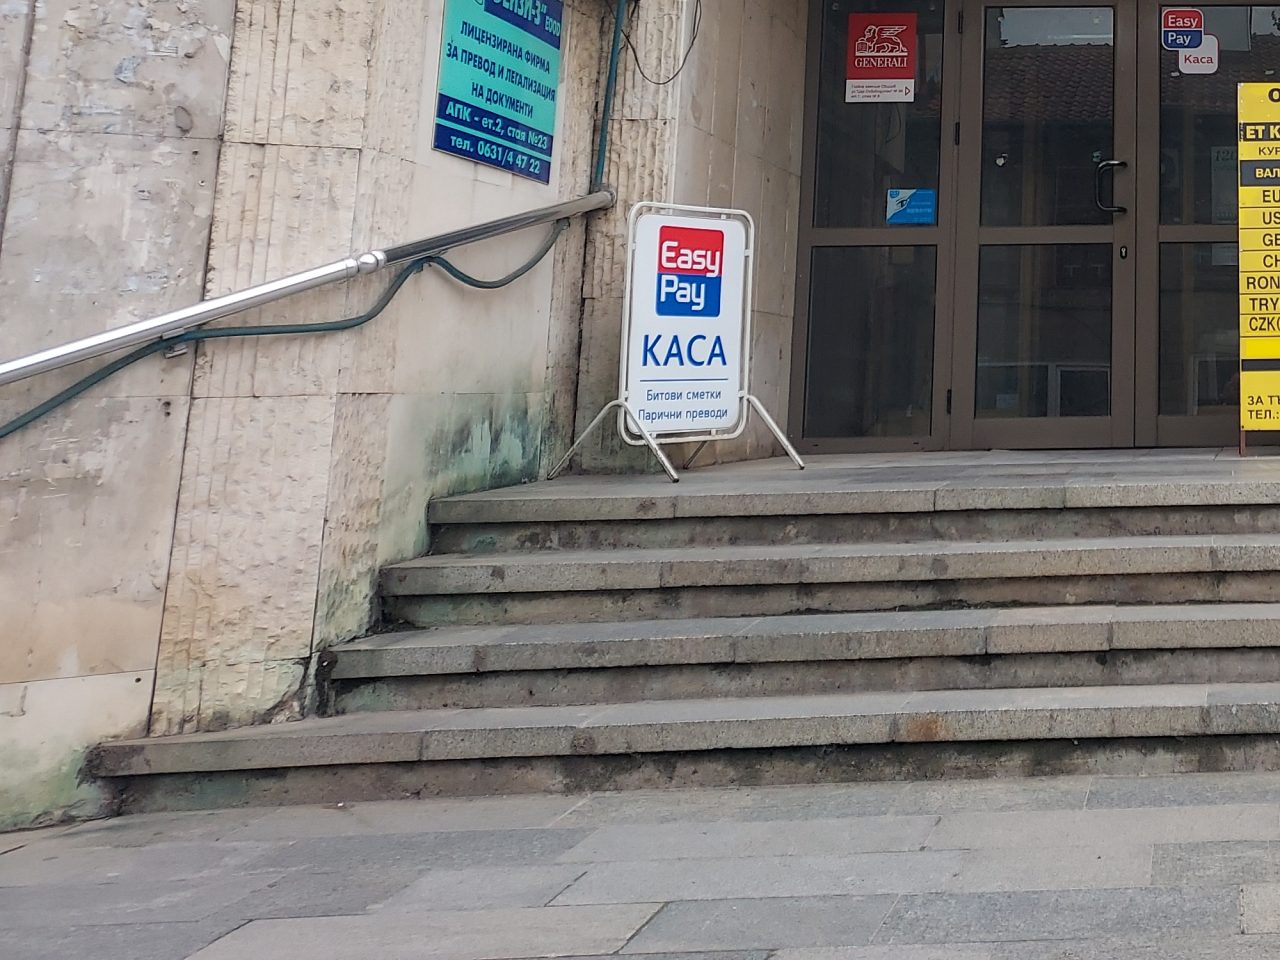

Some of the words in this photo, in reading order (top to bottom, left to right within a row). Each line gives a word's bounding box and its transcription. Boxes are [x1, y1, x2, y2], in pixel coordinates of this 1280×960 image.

[1168, 14, 1198, 28] Easy
[1168, 32, 1191, 46] Pay
[460, 20, 523, 60] ЛИЦЕНЗИРАНА
[525, 50, 550, 75] ФИРМА
[855, 57, 908, 68] GENERALI
[1184, 54, 1214, 64] Каса
[446, 42, 459, 60] ЗА
[460, 48, 496, 78] ПРЕВОД
[498, 65, 504, 79] И
[505, 67, 556, 104] ЛЕГАЛИЗАЦИЯ
[471, 81, 484, 100] НА
[485, 88, 534, 120] ДОКУМЕНТИ
[446, 101, 471, 122] АПК
[507, 125, 527, 142] стая
[527, 132, 548, 150] №23
[1246, 125, 1266, 139] ЕТ
[450, 134, 474, 153] тел.
[515, 153, 528, 170] 47
[528, 158, 541, 175] 22
[660, 240, 720, 277] Easy
[660, 275, 705, 311] Pay
[642, 334, 728, 367] КАСА
[646, 390, 683, 401] Битови
[686, 389, 722, 401] сметки
[1247, 395, 1264, 406] ЗА
[638, 409, 682, 422] Парични
[685, 408, 728, 422] преводи
[1248, 409, 1280, 420] ТЕЛ.:
